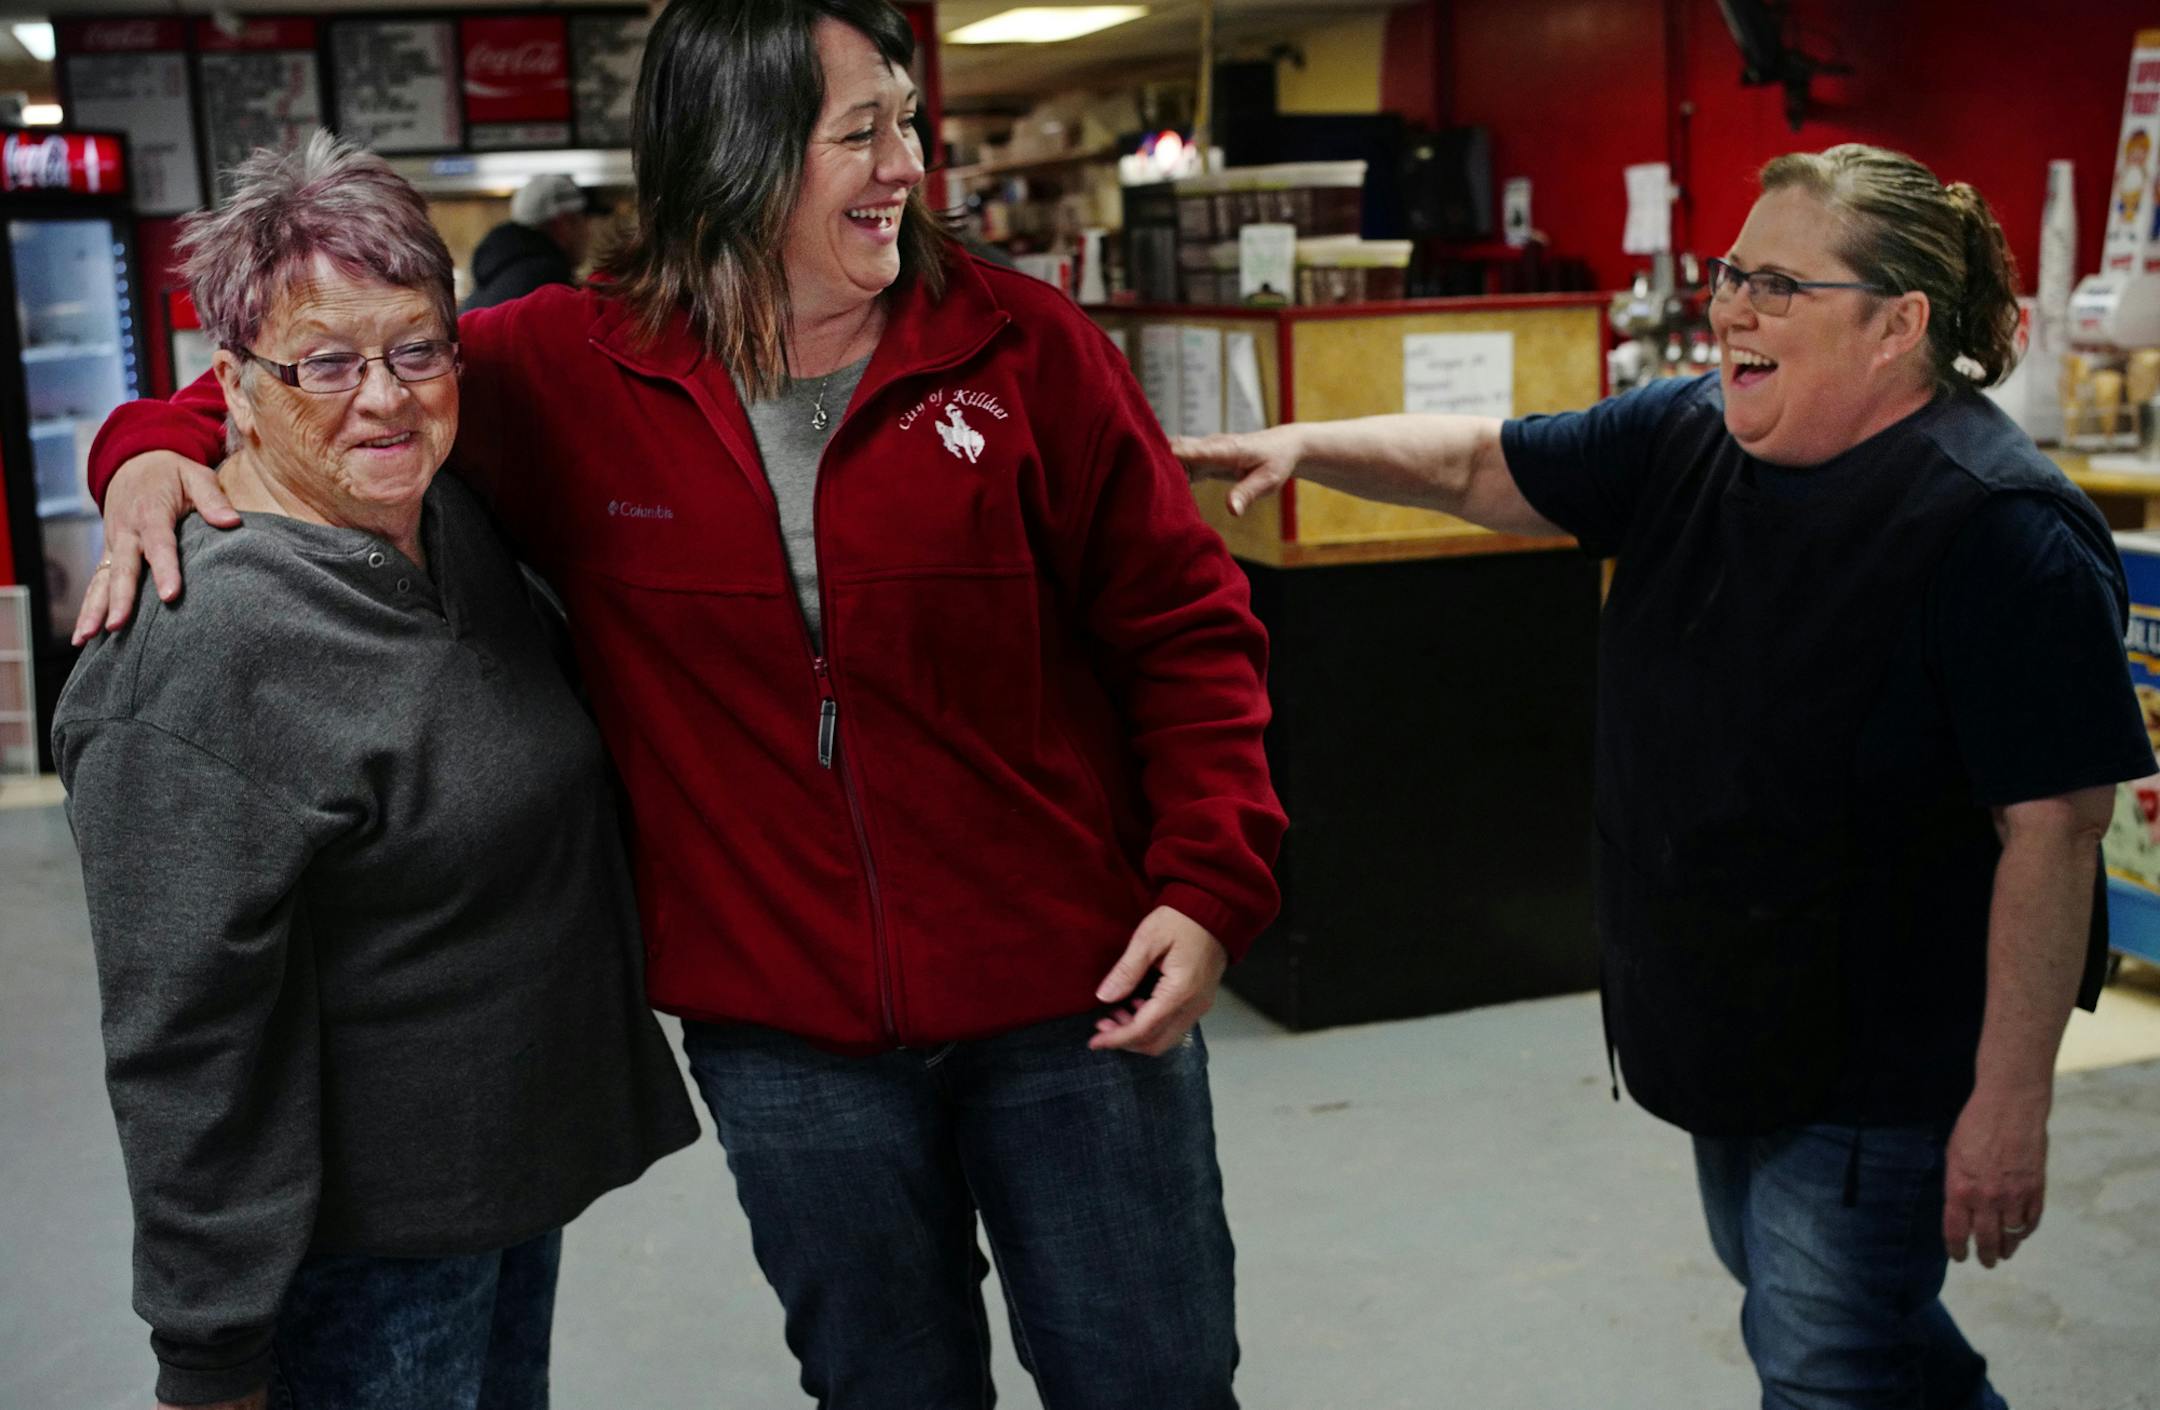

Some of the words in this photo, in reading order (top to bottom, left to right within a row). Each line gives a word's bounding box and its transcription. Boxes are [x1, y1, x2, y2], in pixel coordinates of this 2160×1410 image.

[898, 402, 926, 431] City
[928, 387, 944, 408] of
[953, 388, 1009, 421] Killdeer
[619, 501, 674, 520] Columbia
